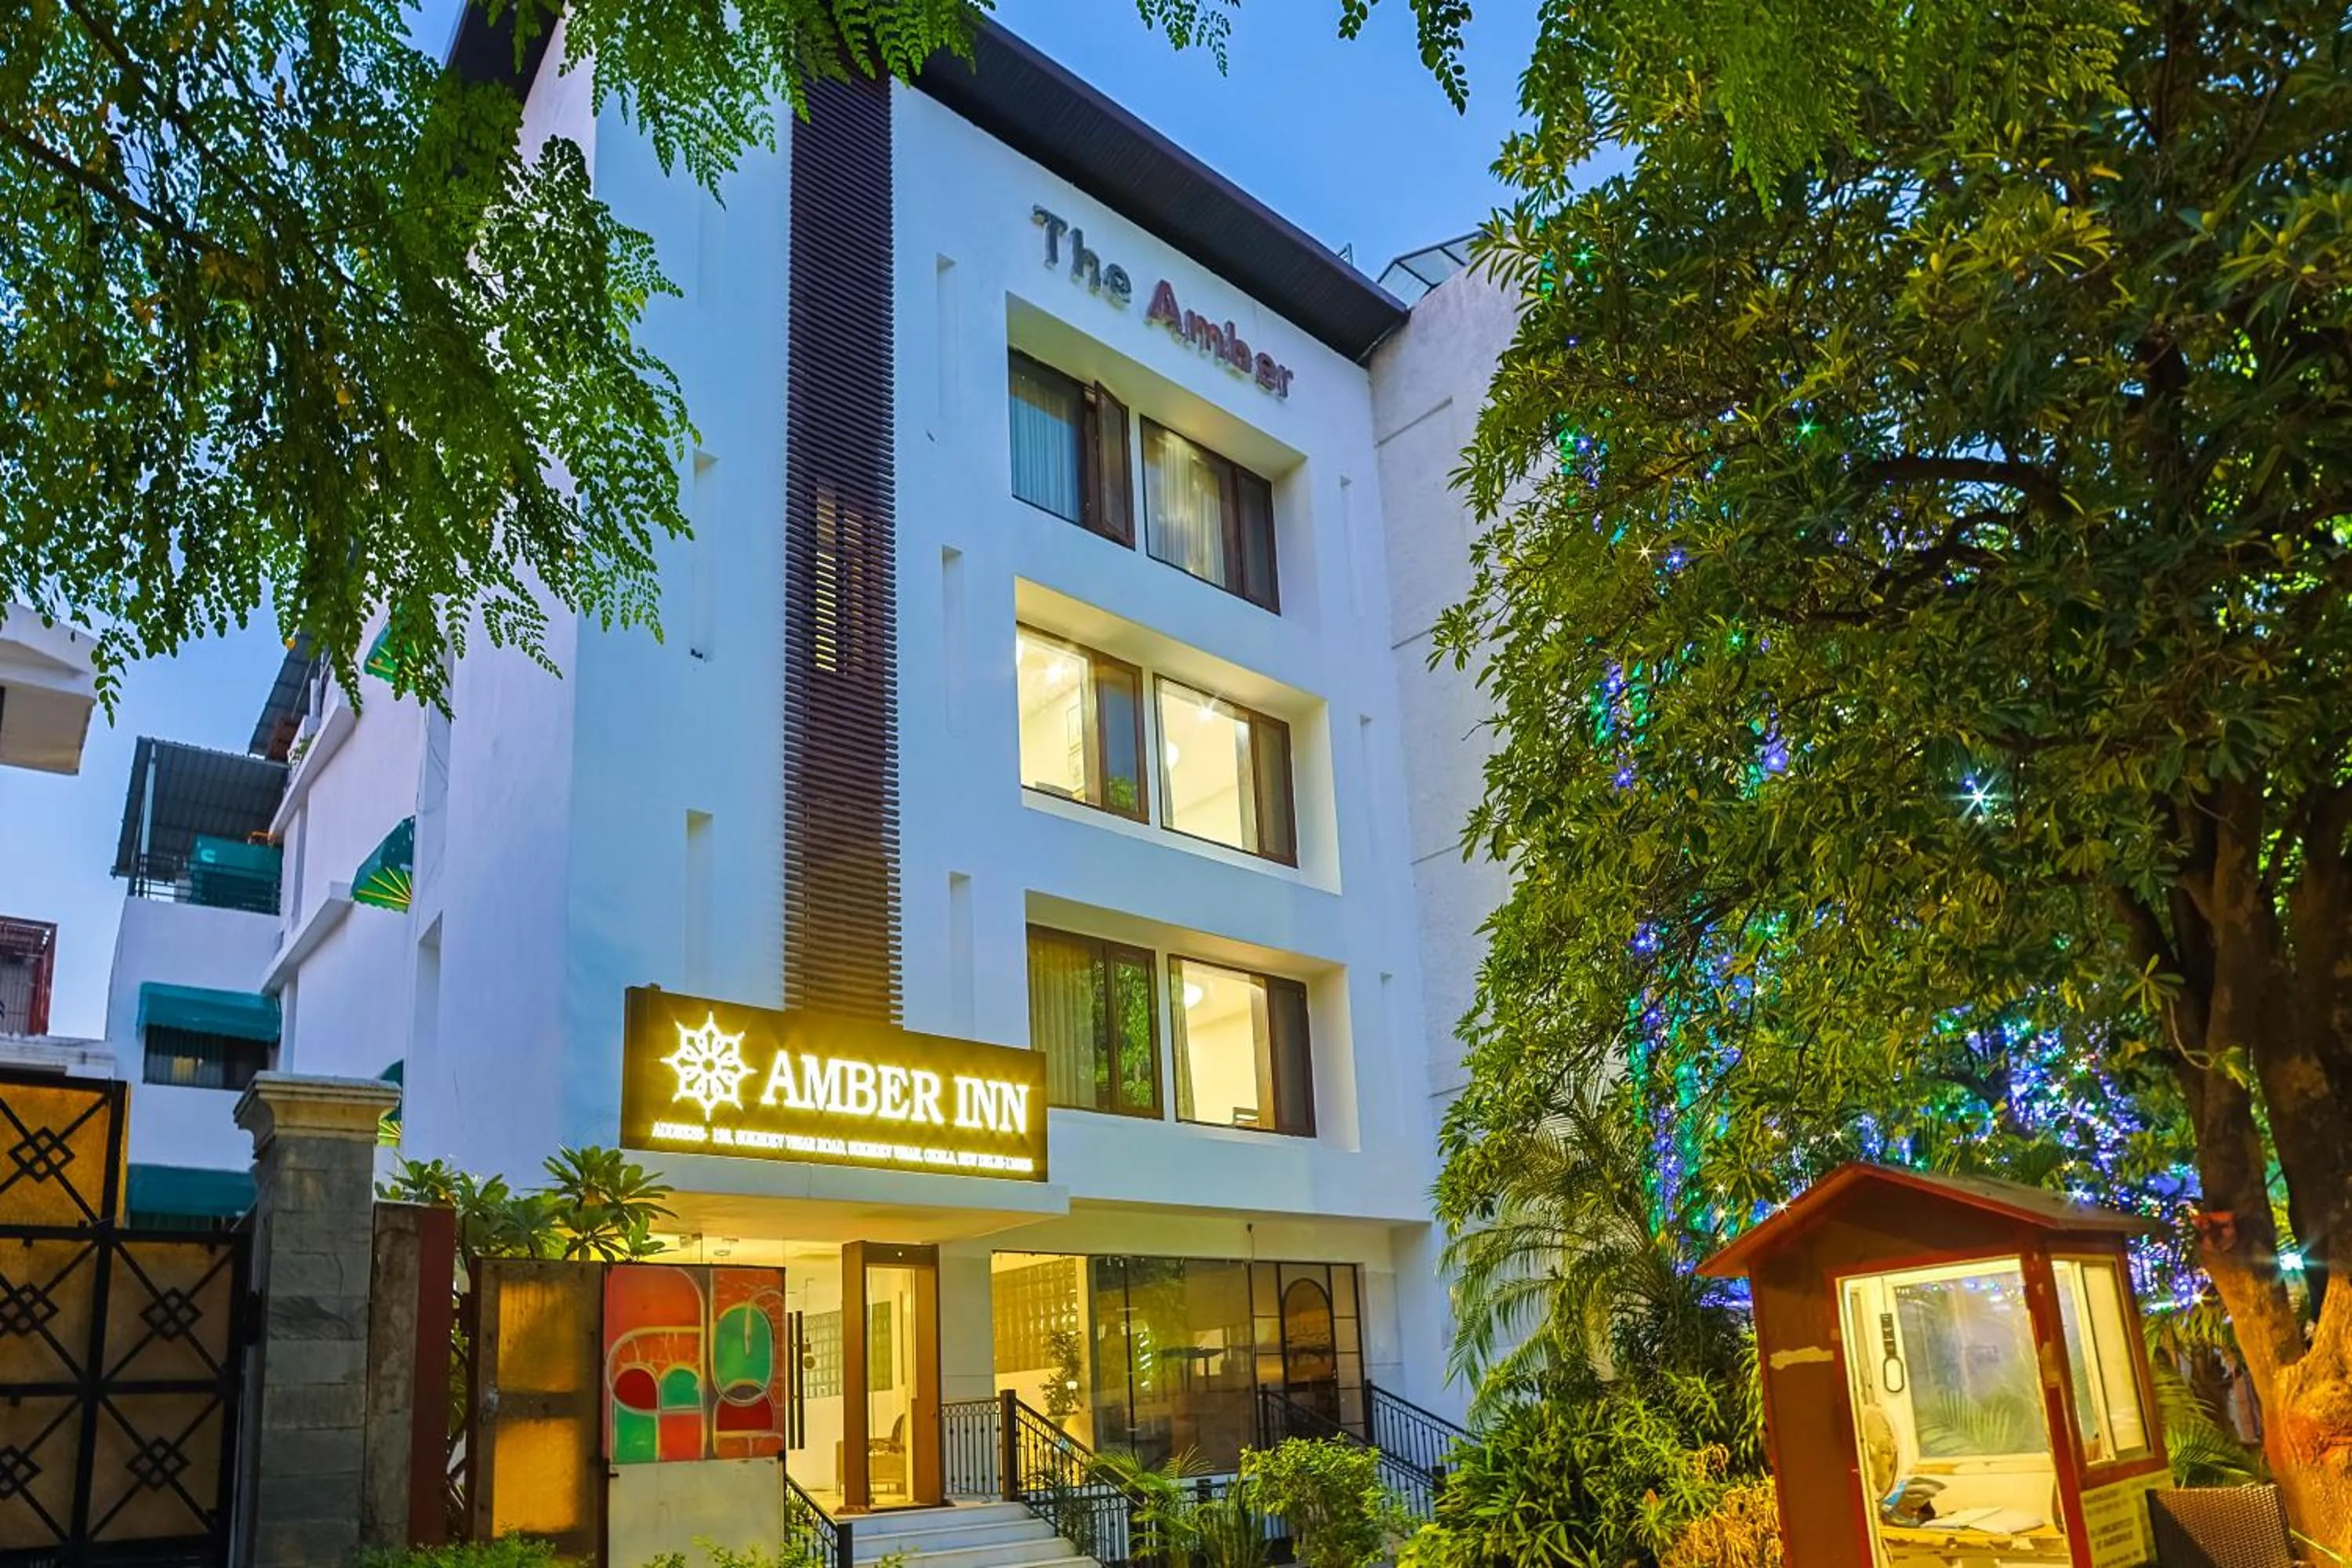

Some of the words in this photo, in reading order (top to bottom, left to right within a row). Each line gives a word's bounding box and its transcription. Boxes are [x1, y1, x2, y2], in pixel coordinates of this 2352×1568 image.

[1031, 204, 1132, 307] The
[1145, 279, 1294, 399] Amber
[760, 1049, 944, 1124] AMBER
[954, 1075, 1029, 1134] INN
